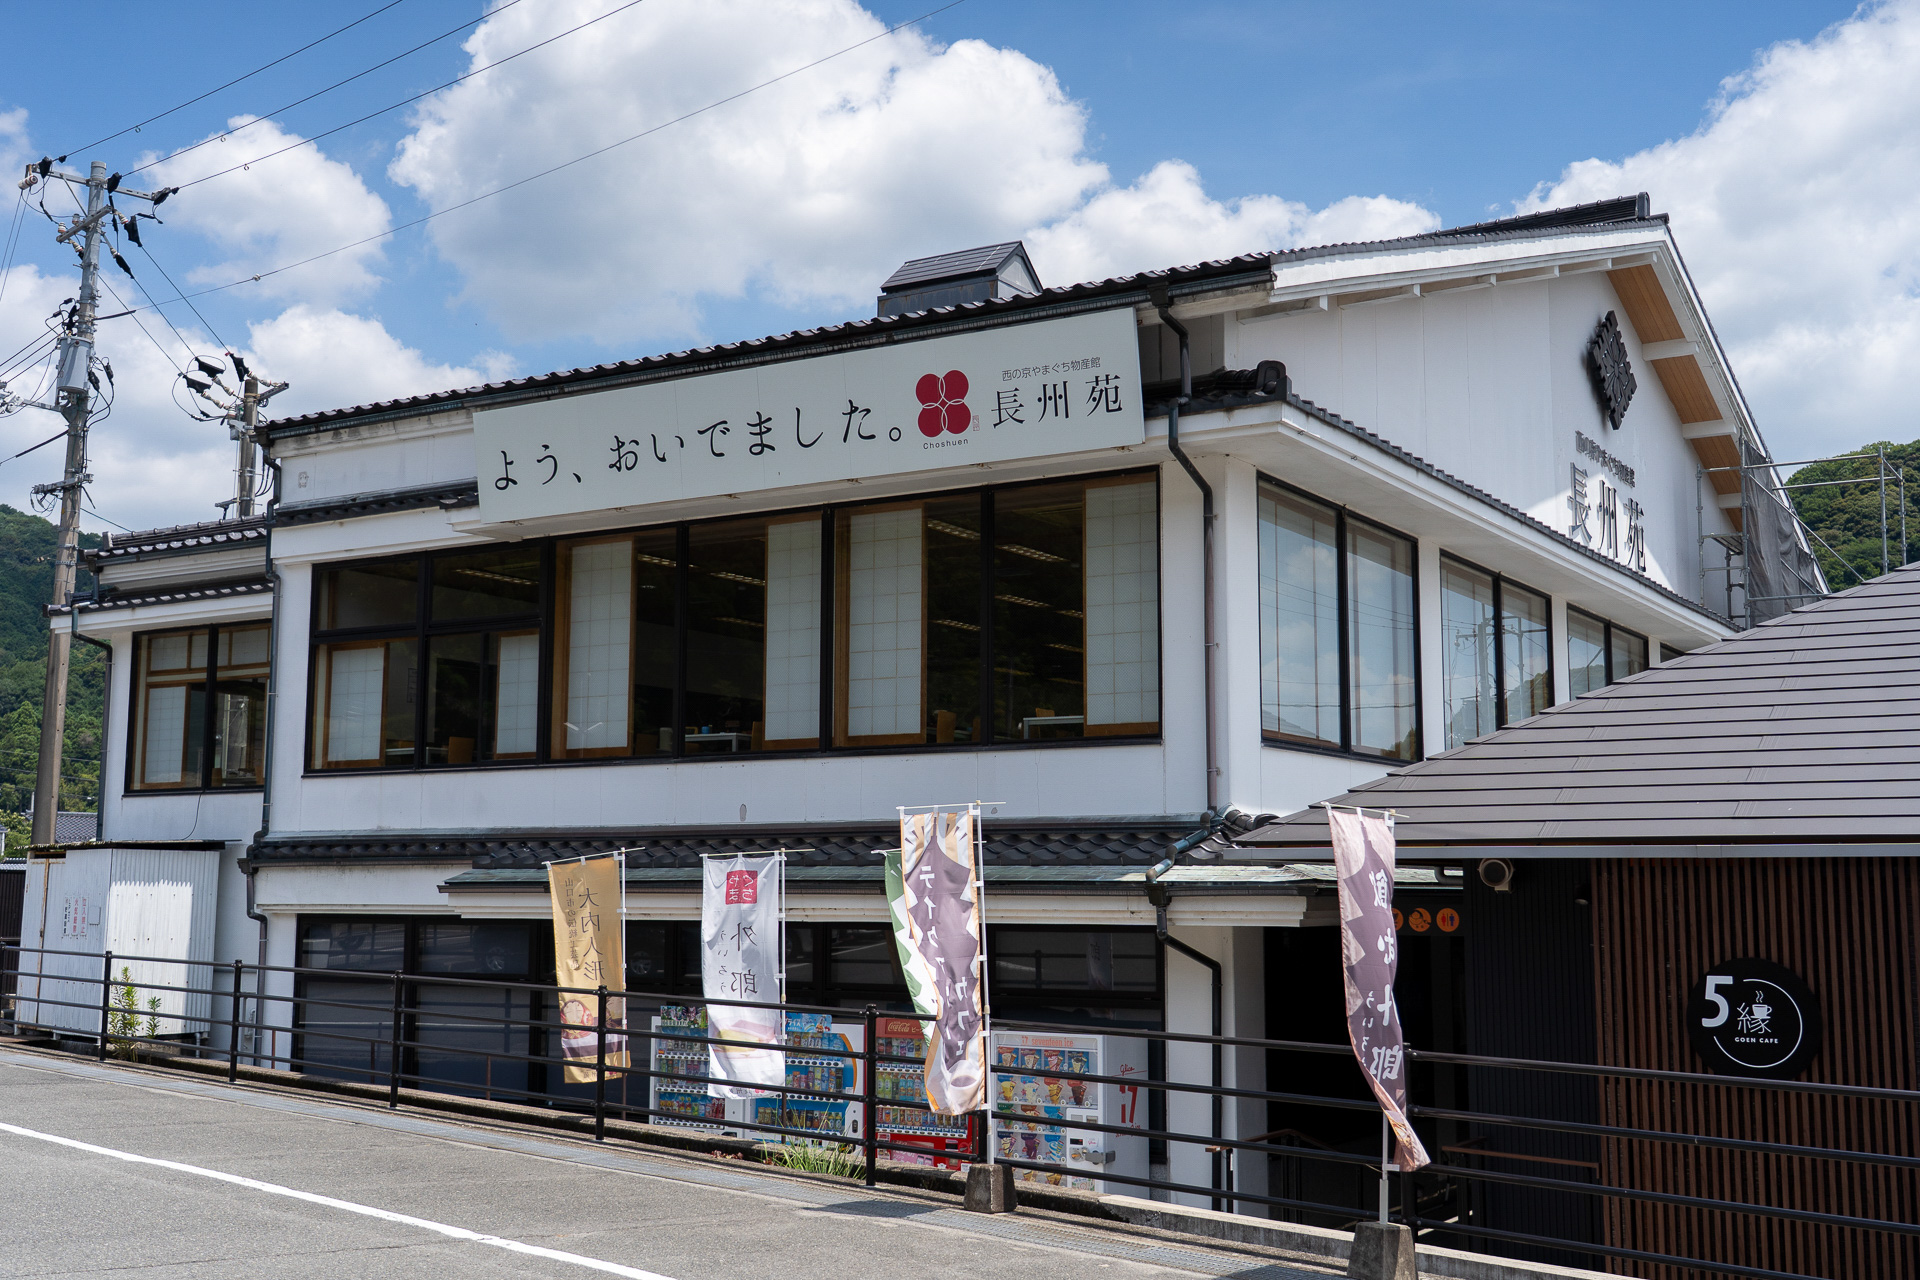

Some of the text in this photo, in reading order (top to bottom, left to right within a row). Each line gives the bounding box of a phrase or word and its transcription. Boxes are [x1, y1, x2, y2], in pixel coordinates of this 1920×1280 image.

[1002, 357, 1101, 382] 西の京やまぐち物産館
[991, 374, 1122, 428] 長州苑
[494, 399, 902, 491] よう、おいでました。
[923, 438, 969, 450] Choshuen
[1567, 462, 1647, 573] 長州苑
[888, 1021, 910, 1033] Coca-Cola
[1032, 1037, 1062, 1048] seventeen
[1064, 1037, 1074, 1048] ice
[1120, 1064, 1135, 1076] Glico
